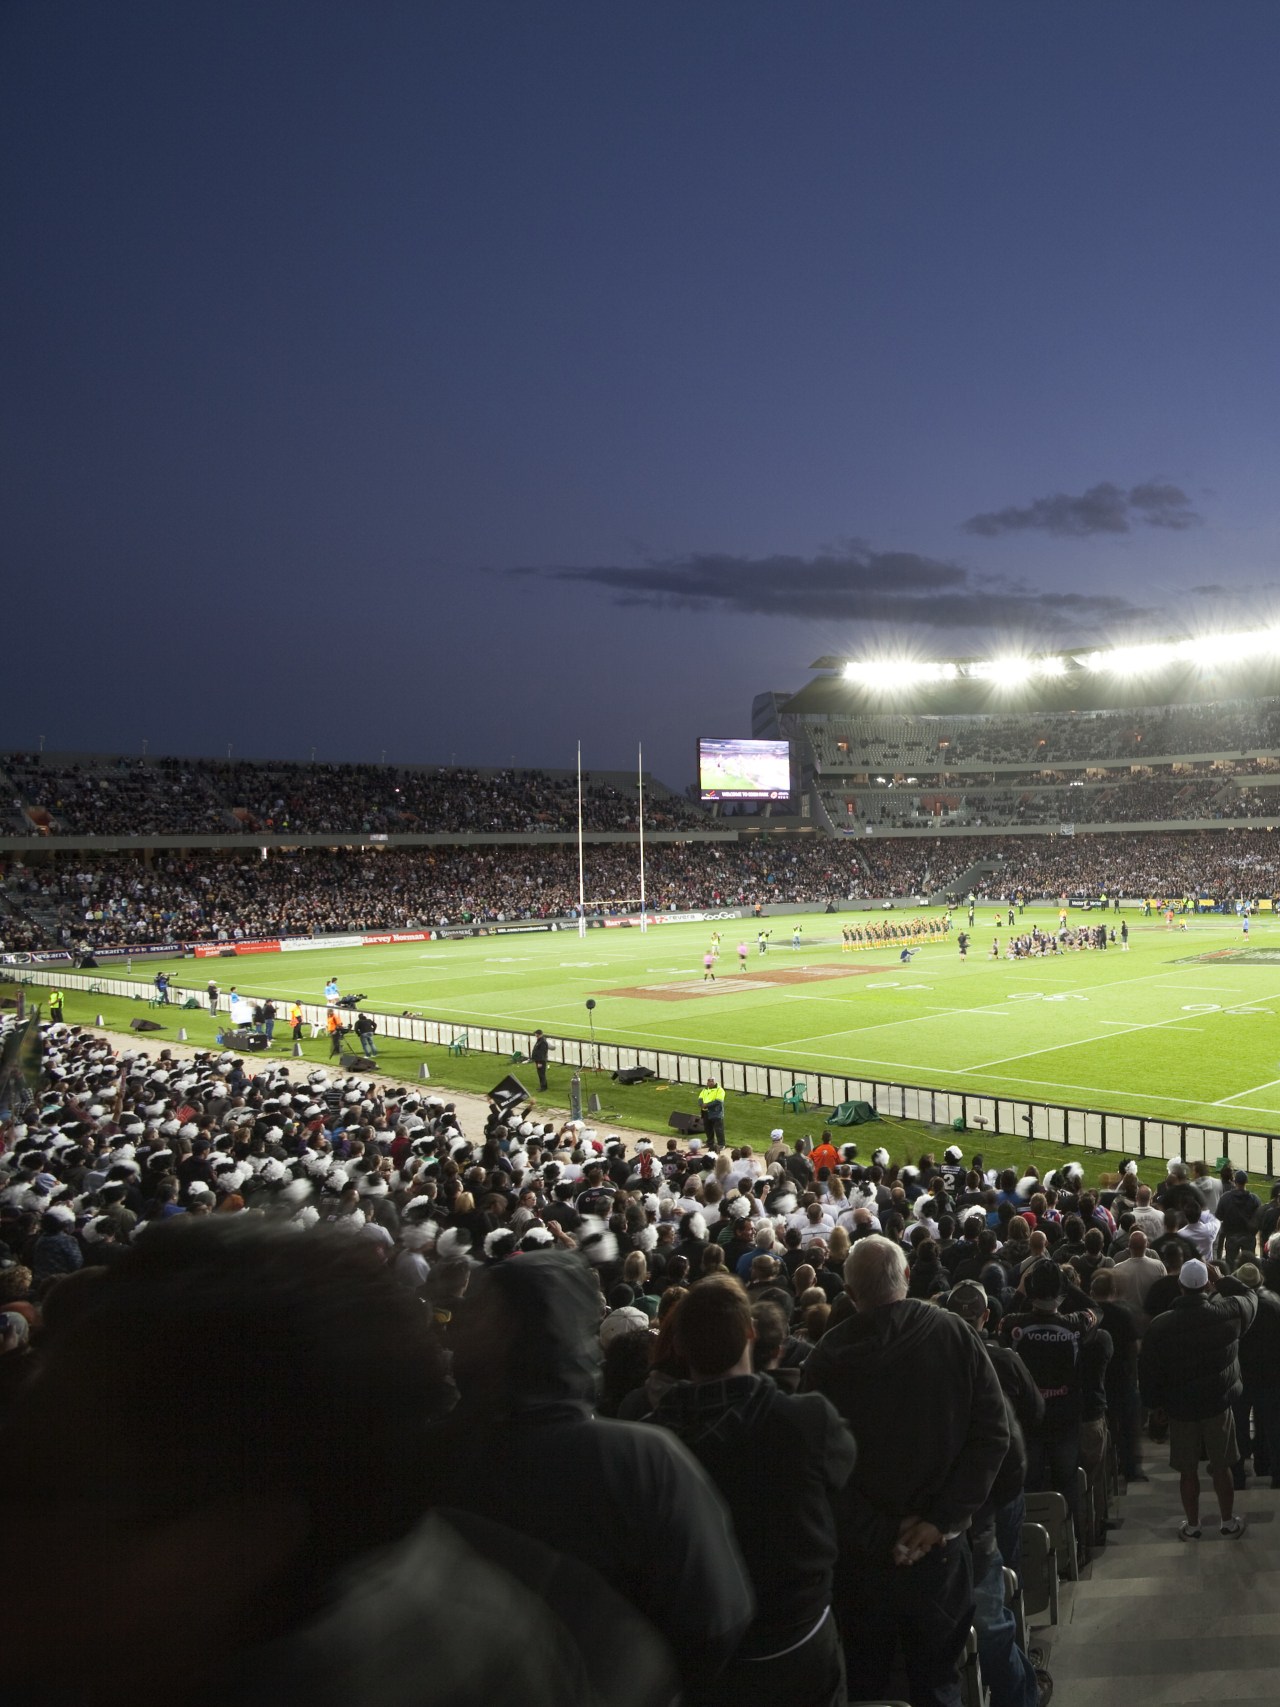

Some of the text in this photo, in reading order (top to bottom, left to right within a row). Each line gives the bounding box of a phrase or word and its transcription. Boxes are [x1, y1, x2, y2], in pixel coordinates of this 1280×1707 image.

[702, 911, 736, 921] KooGa
[361, 935, 392, 944] Harvey
[393, 933, 425, 942] Norman
[943, 1173, 955, 1190] 2
[1027, 1330, 1080, 1342] vodafone
